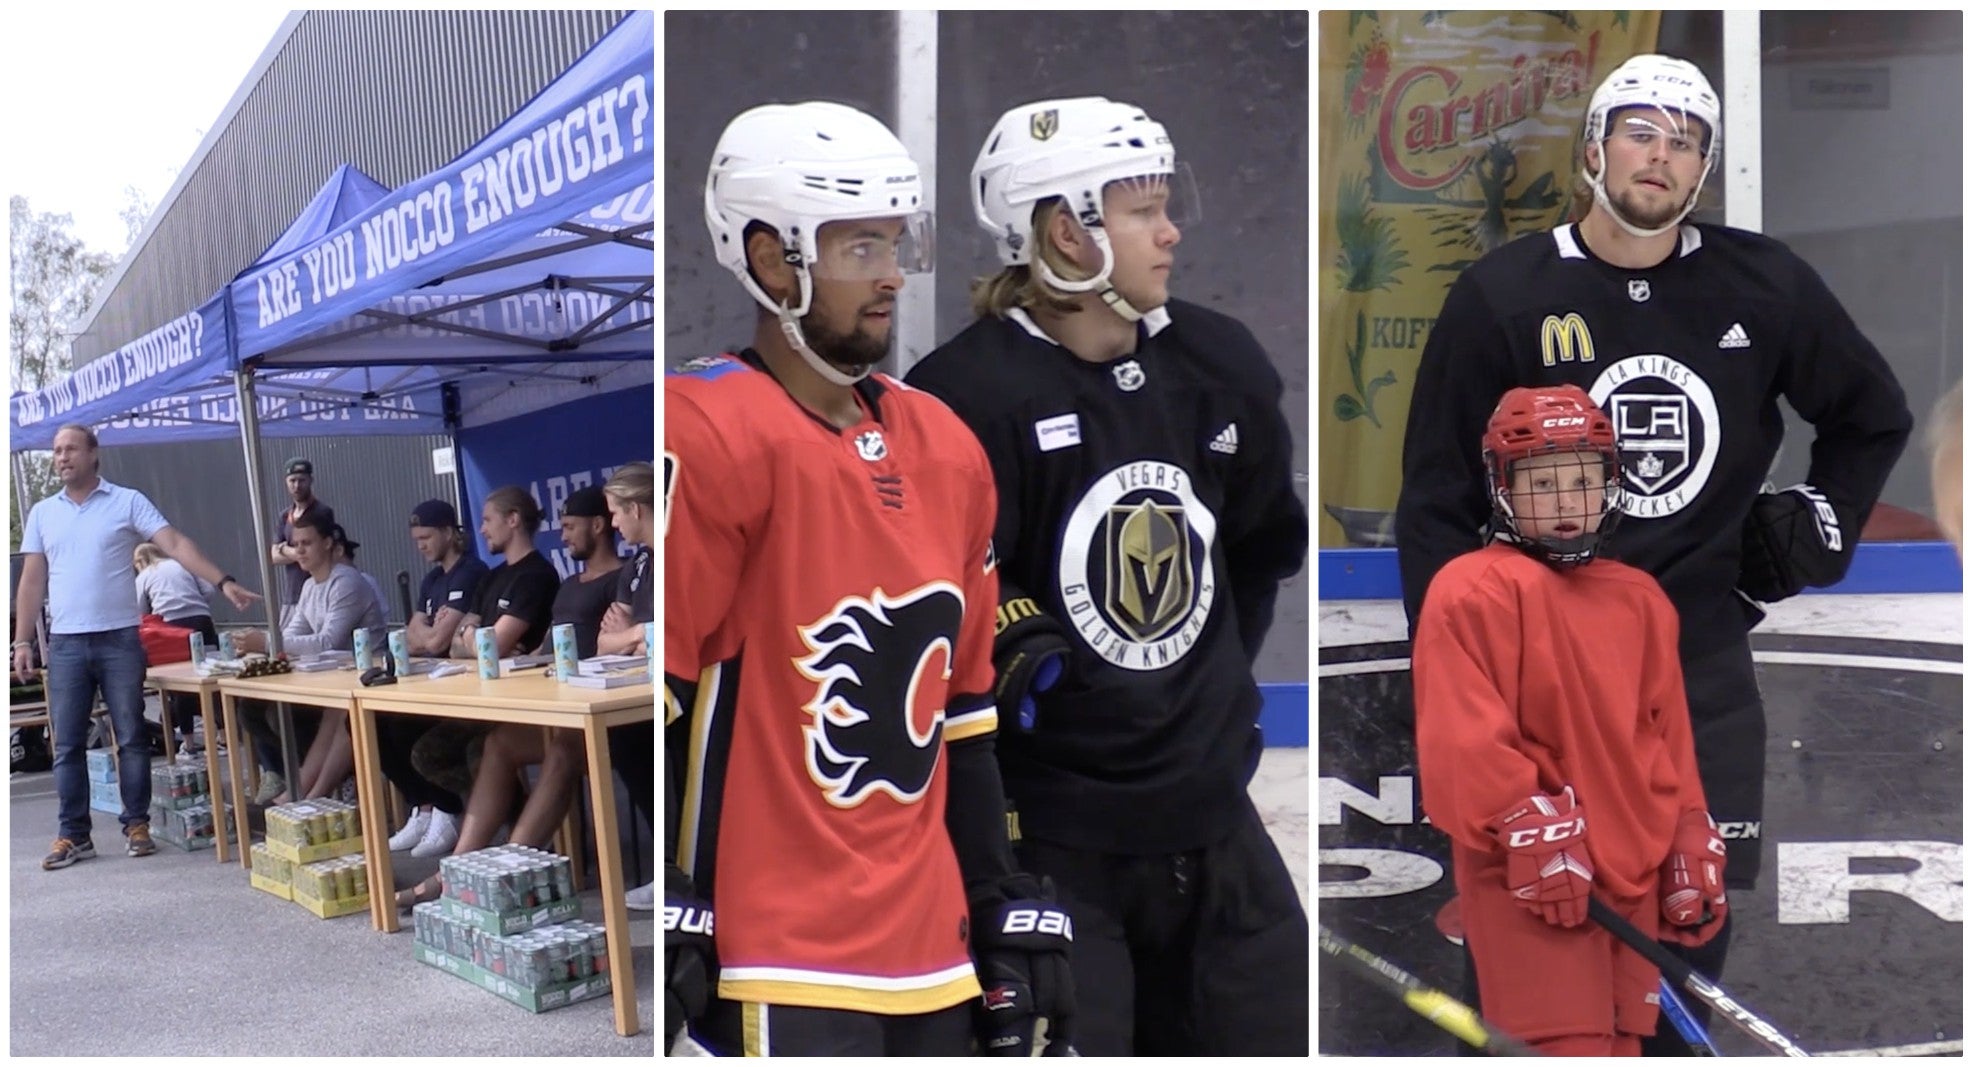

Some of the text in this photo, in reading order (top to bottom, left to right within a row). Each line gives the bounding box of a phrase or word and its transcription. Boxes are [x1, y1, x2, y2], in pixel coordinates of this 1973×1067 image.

[1653, 75, 1693, 87] CCM
[1377, 30, 1600, 190] Carnival
[258, 261, 302, 328] ARE
[302, 231, 357, 305] YOU
[362, 181, 456, 281] NOCCO
[461, 74, 650, 235] ENOUGH?
[1371, 317, 1436, 349] KOF
[18, 311, 204, 427] ARE YOU NOCCO ENOUGH?
[1607, 358, 1691, 386] LA KINGS
[1543, 417, 1586, 428] CCM
[1619, 405, 1682, 435] LA
[1116, 464, 1181, 492] VEGAS
[1625, 489, 1686, 516] OCKEY
[1064, 583, 1129, 664] GOLDEN
[1142, 584, 1214, 667] KNIGHTS
